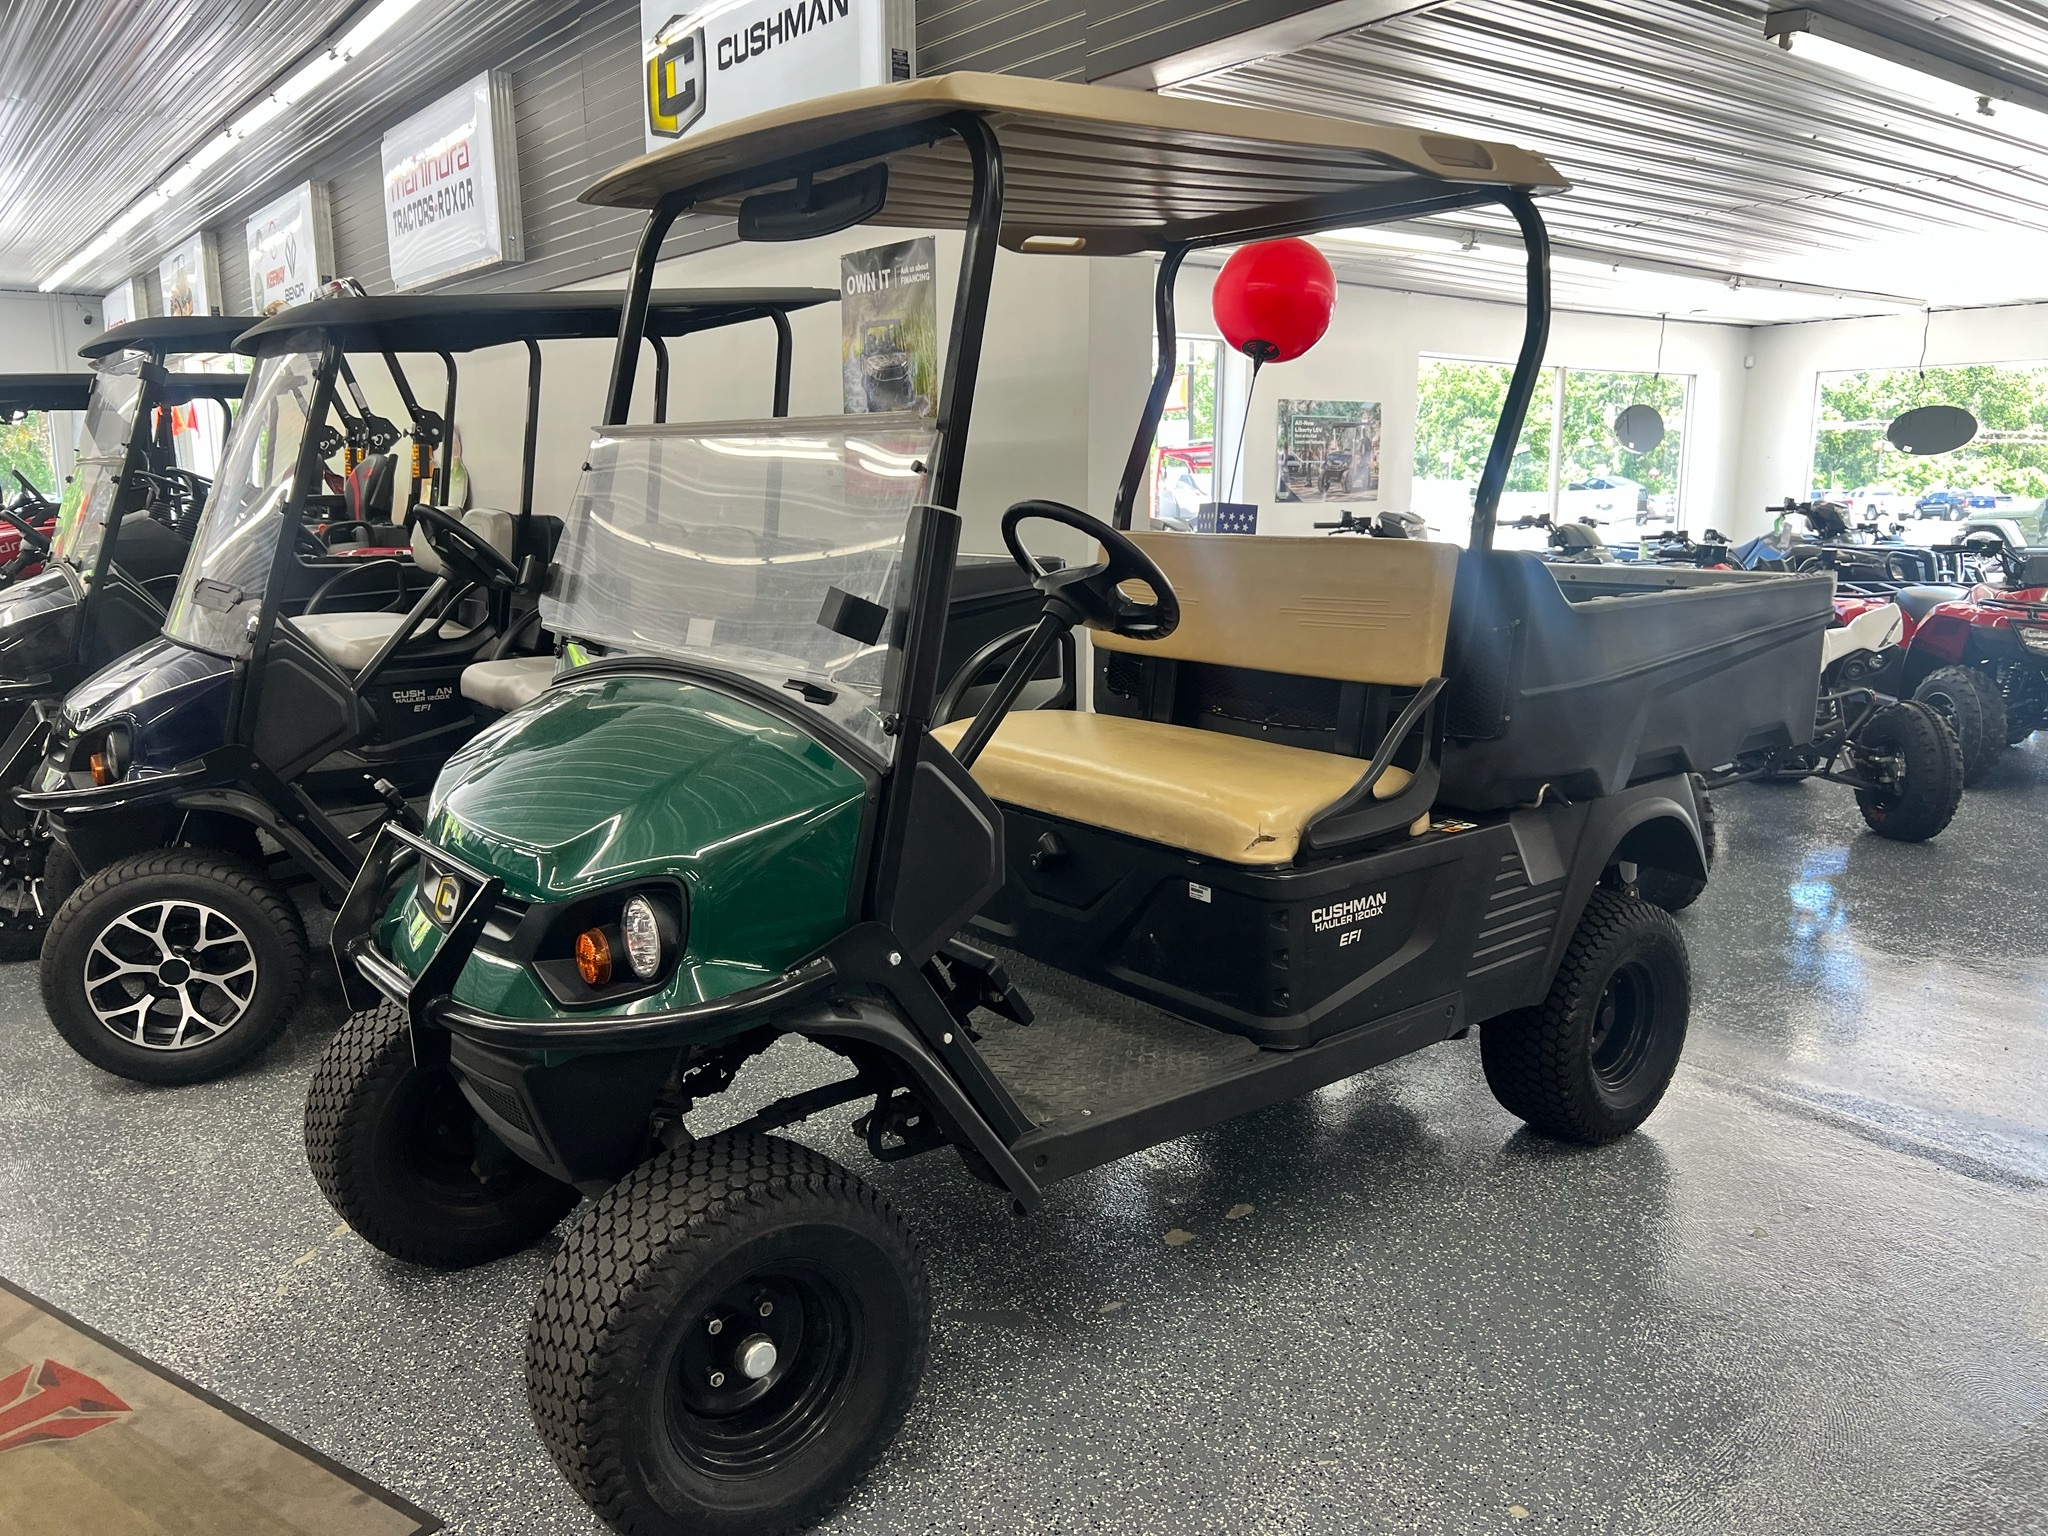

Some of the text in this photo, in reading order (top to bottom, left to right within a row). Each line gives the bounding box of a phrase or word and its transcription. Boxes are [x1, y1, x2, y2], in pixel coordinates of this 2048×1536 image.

[717, 0, 848, 71] CUSHMAN
[900, 266, 909, 274] Ask
[915, 262, 929, 272] about
[846, 268, 891, 296] OWN IT
[900, 272, 930, 286] FINANCING
[395, 696, 426, 704] HAULER
[413, 703, 432, 713] EFI
[1311, 891, 1387, 924] CUSHMAN
[1314, 905, 1384, 933] HAULER 1200X
[1339, 928, 1362, 947] EFI
